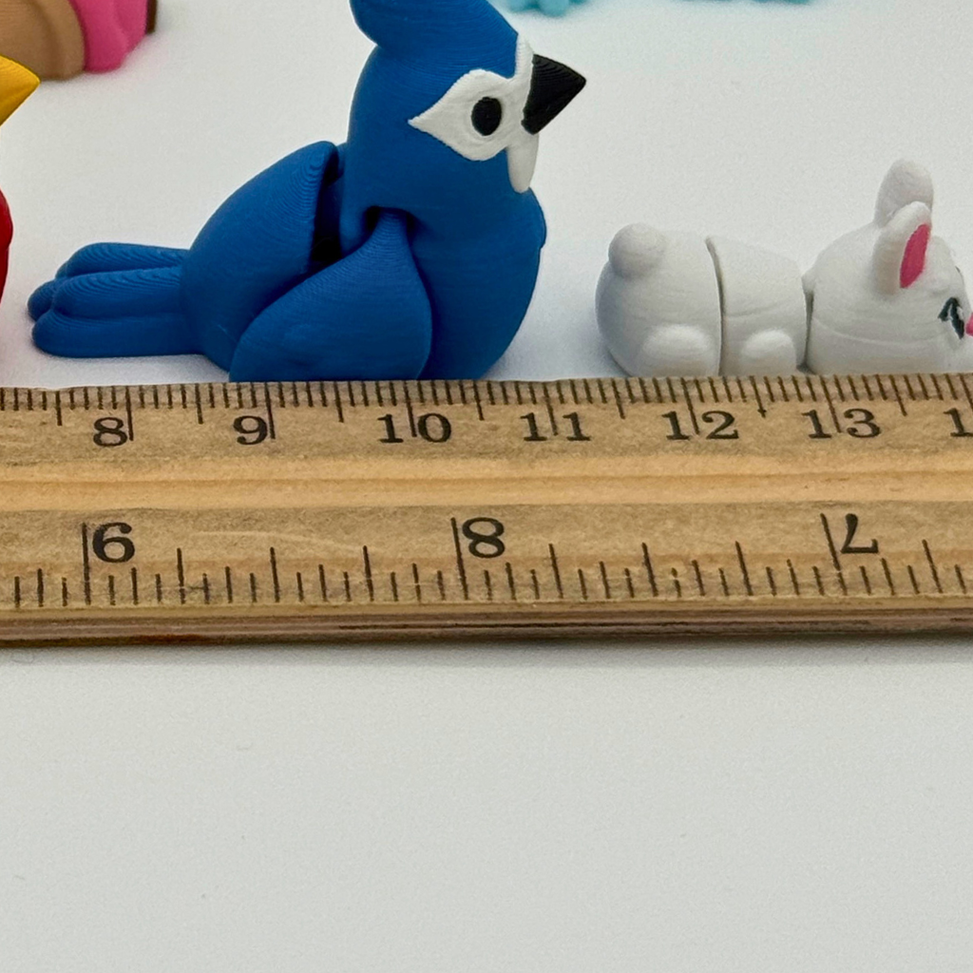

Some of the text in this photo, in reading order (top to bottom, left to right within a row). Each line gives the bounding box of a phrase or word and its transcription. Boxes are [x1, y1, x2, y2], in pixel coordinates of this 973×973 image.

[92, 417, 128, 447] 8
[232, 415, 268, 445] 9
[377, 413, 452, 443] 10
[520, 413, 591, 442] 11
[662, 410, 740, 440] 12
[802, 408, 882, 439] 13
[461, 517, 506, 558] 8
[841, 513, 879, 554] 7
